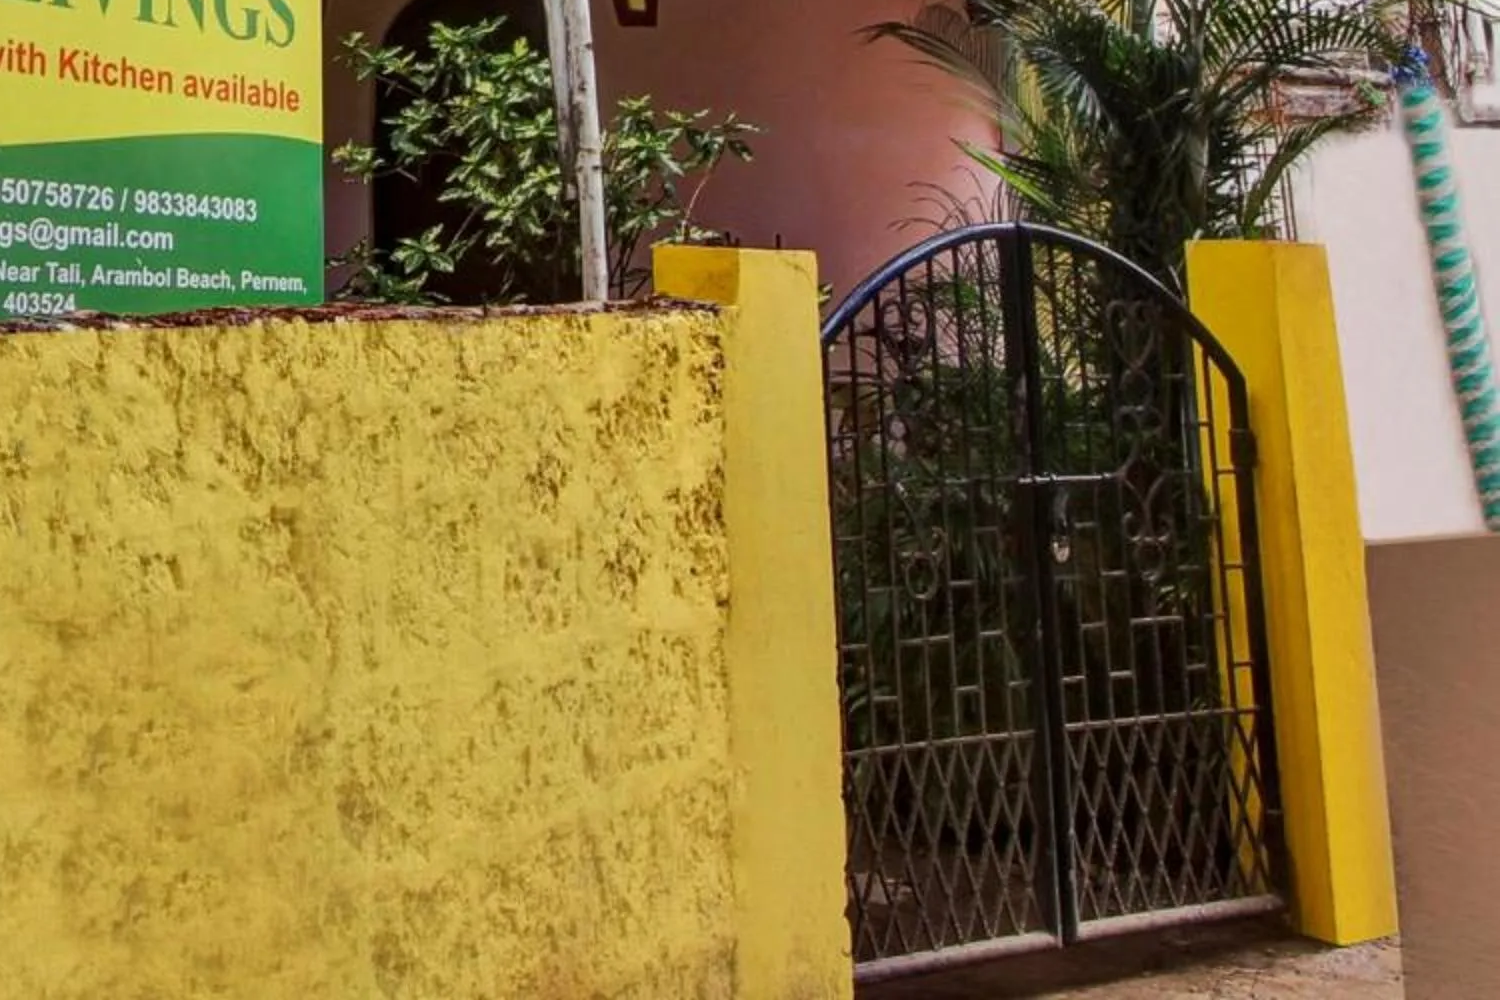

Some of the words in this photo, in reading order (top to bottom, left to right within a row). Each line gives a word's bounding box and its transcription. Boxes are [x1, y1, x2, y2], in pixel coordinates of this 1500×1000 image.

[58, 47, 174, 95] Kitchen
[182, 73, 301, 112] available
[133, 189, 258, 223] 9833843083
[45, 261, 86, 288] Tali,
[90, 263, 171, 288] Arambol
[175, 267, 237, 294] Beach,
[240, 270, 308, 296] Pernem,
[2, 291, 76, 316] 403524
